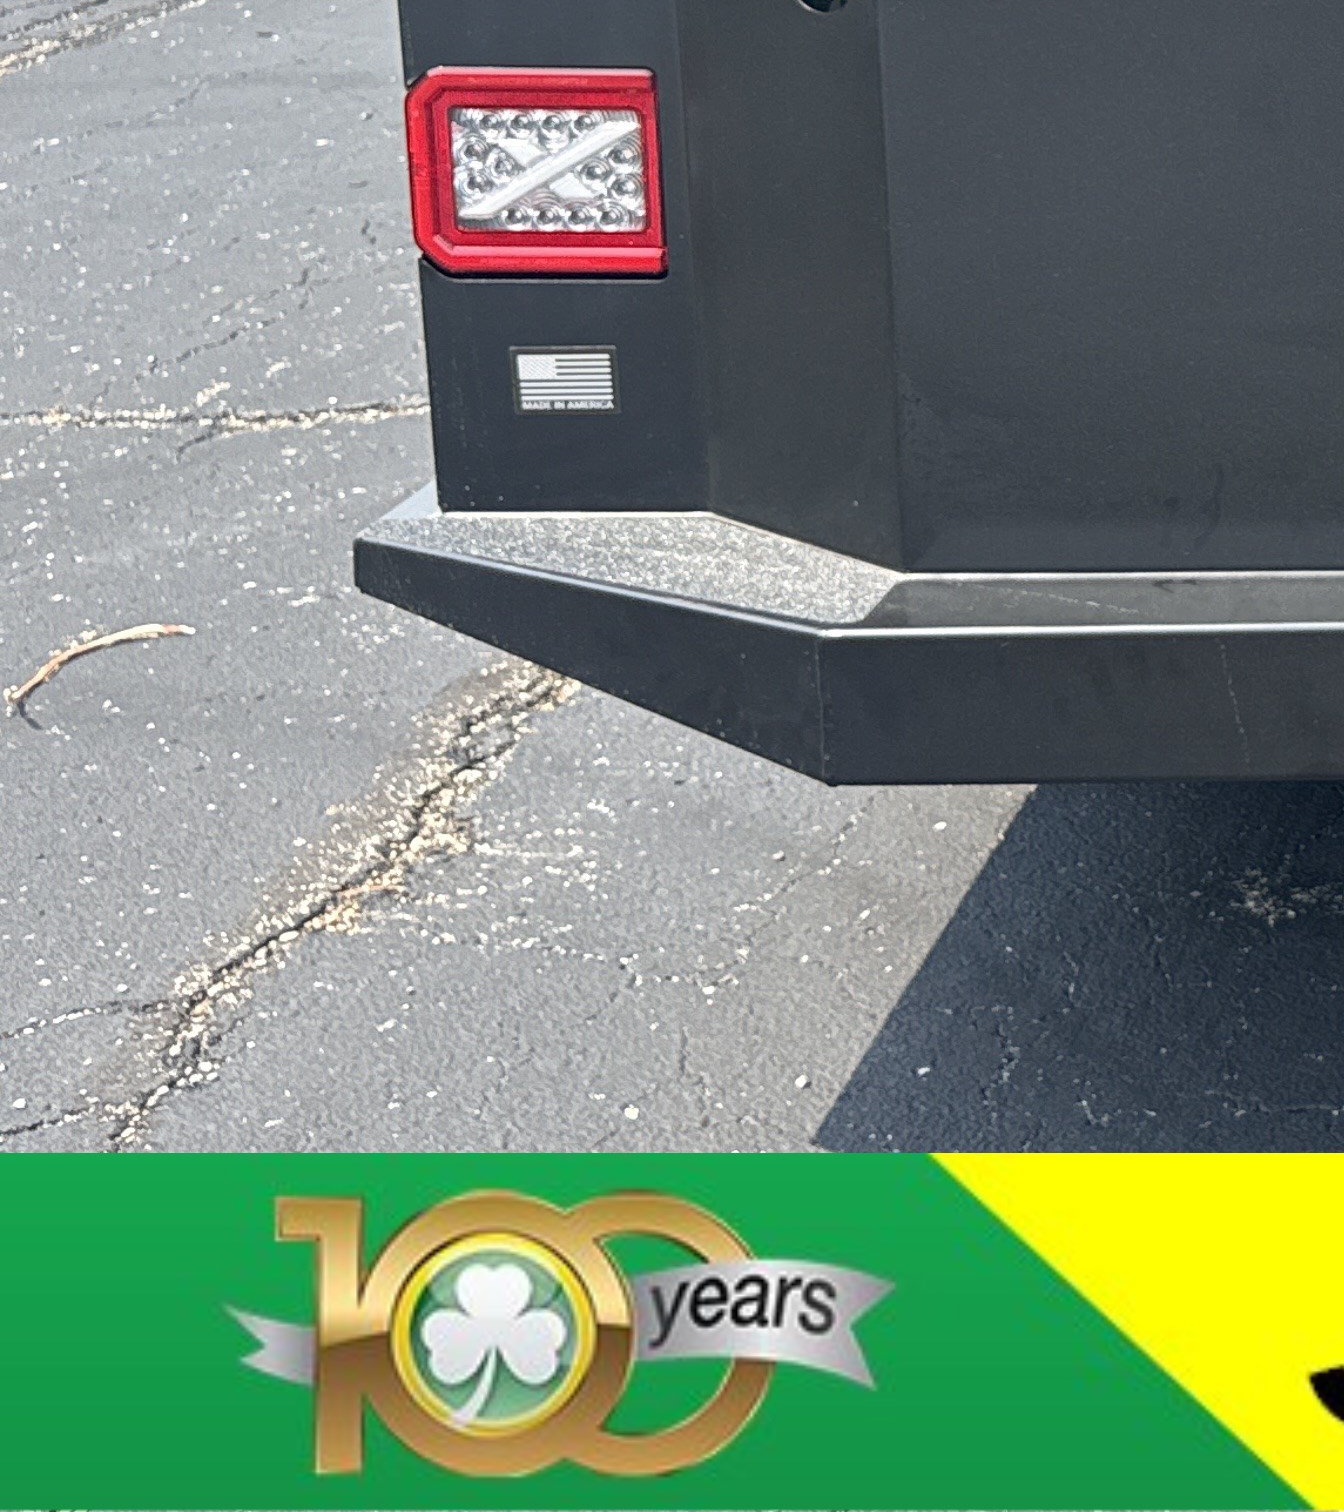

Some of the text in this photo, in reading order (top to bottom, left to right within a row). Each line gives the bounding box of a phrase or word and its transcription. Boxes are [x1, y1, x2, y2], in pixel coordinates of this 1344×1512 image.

[522, 400, 614, 410] MADE IN AMERICA
